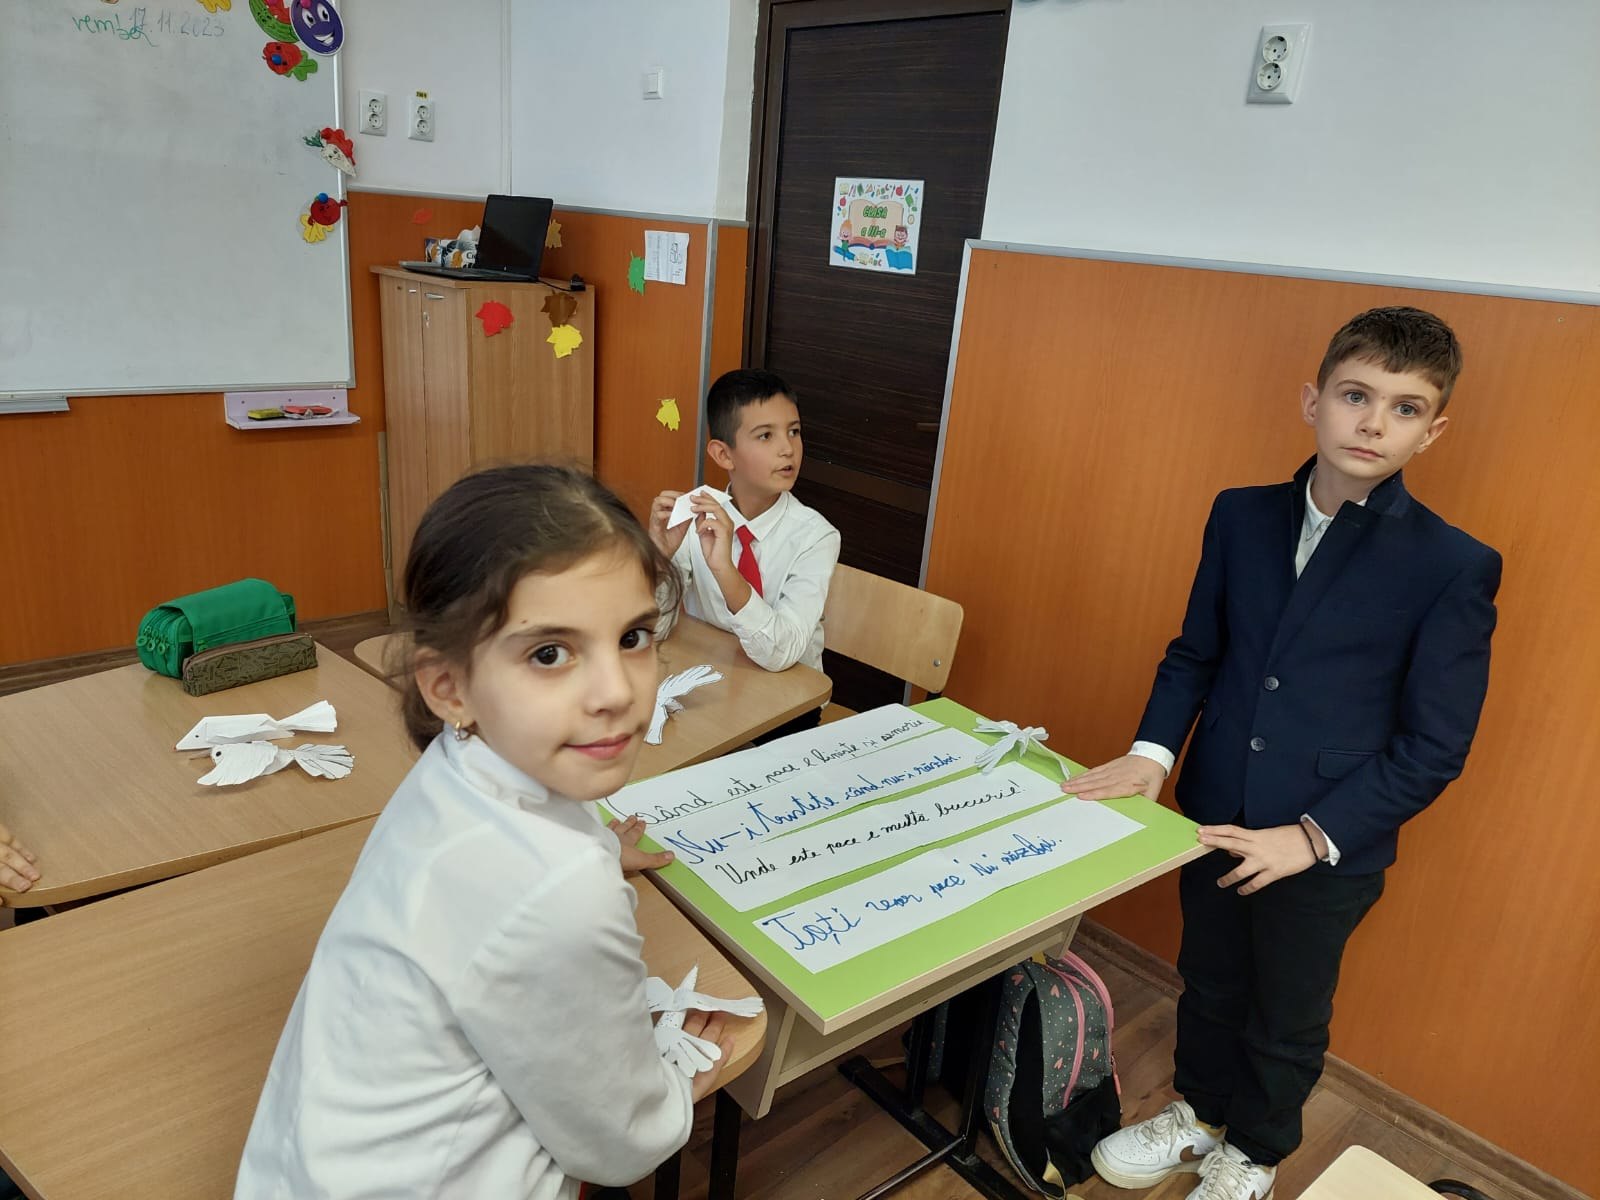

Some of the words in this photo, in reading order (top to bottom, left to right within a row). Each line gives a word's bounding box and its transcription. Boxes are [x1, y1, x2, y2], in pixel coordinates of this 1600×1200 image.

[727, 777, 763, 797] este
[766, 763, 801, 783] pace
[715, 857, 778, 885] Unde
[789, 847, 822, 867] este
[826, 837, 861, 854] pace
[867, 830, 881, 842] e
